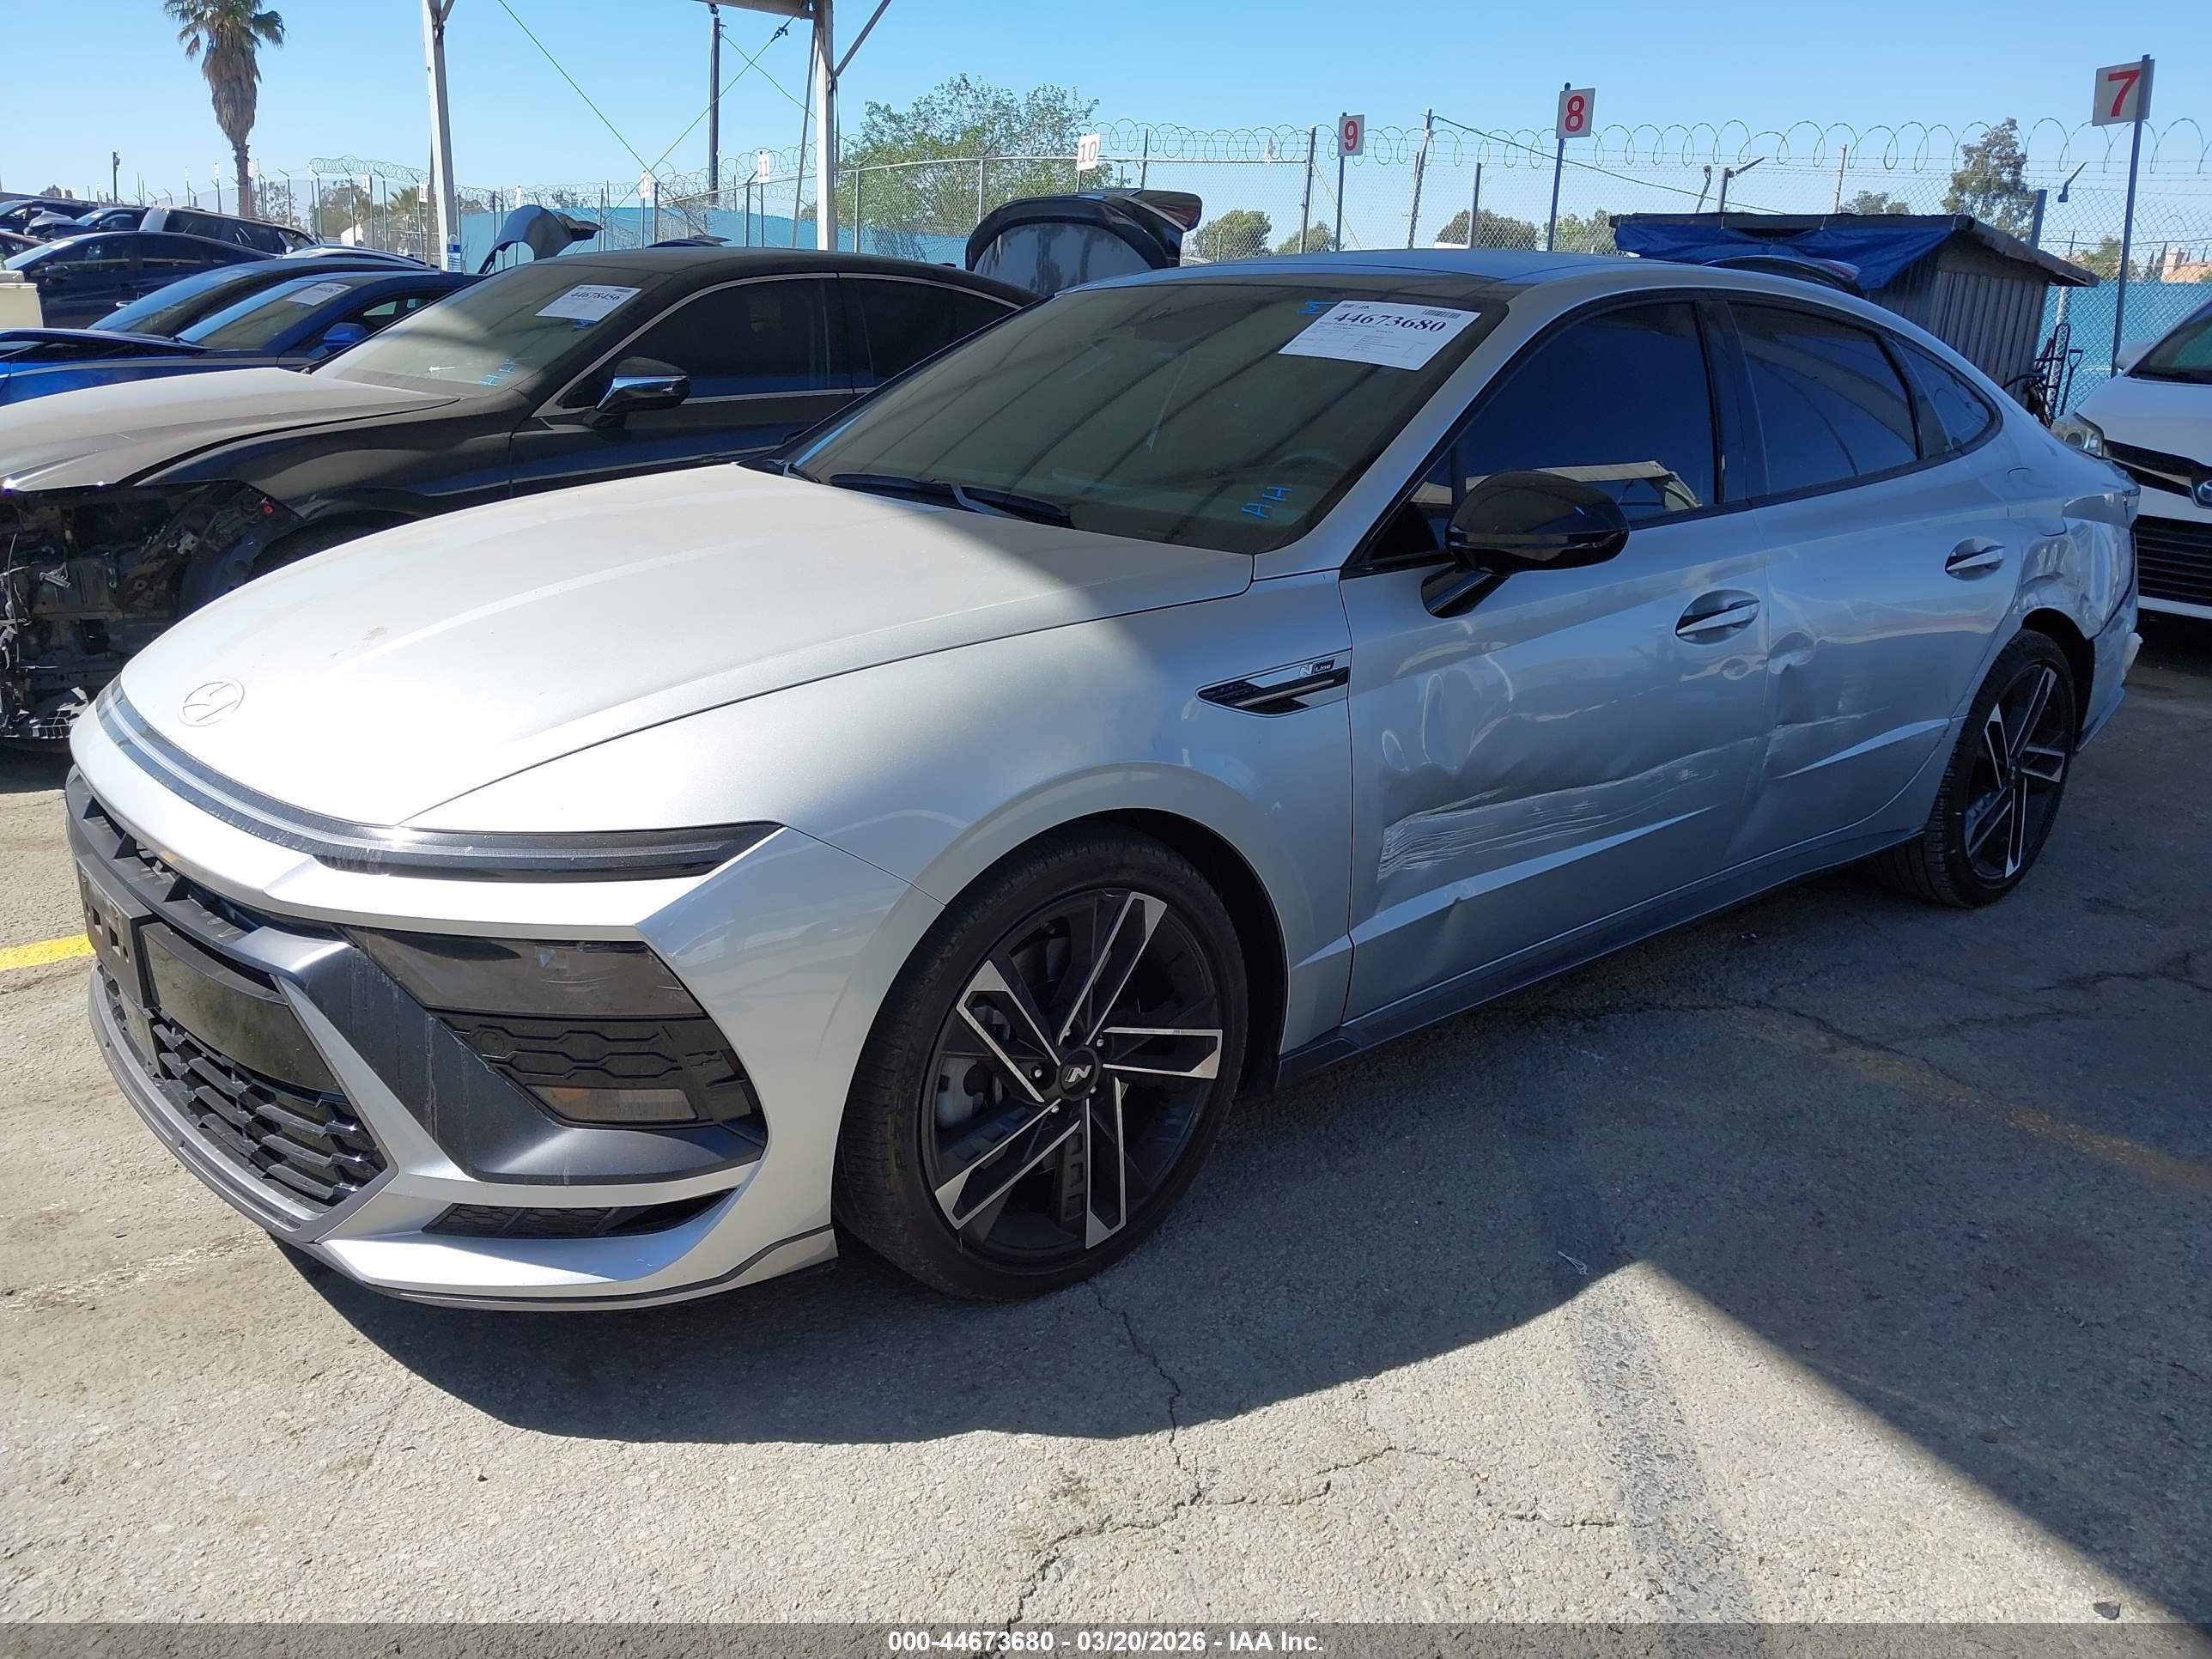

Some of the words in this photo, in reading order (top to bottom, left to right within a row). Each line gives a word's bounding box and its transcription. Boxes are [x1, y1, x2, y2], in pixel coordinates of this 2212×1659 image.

[2108, 69, 2140, 117] 7
[1565, 95, 1584, 132] 8
[1344, 120, 1358, 151] 9
[1079, 141, 1097, 163] 10
[759, 160, 769, 178] 11
[1334, 312, 1447, 333] 44673680
[1298, 664, 1313, 678] N
